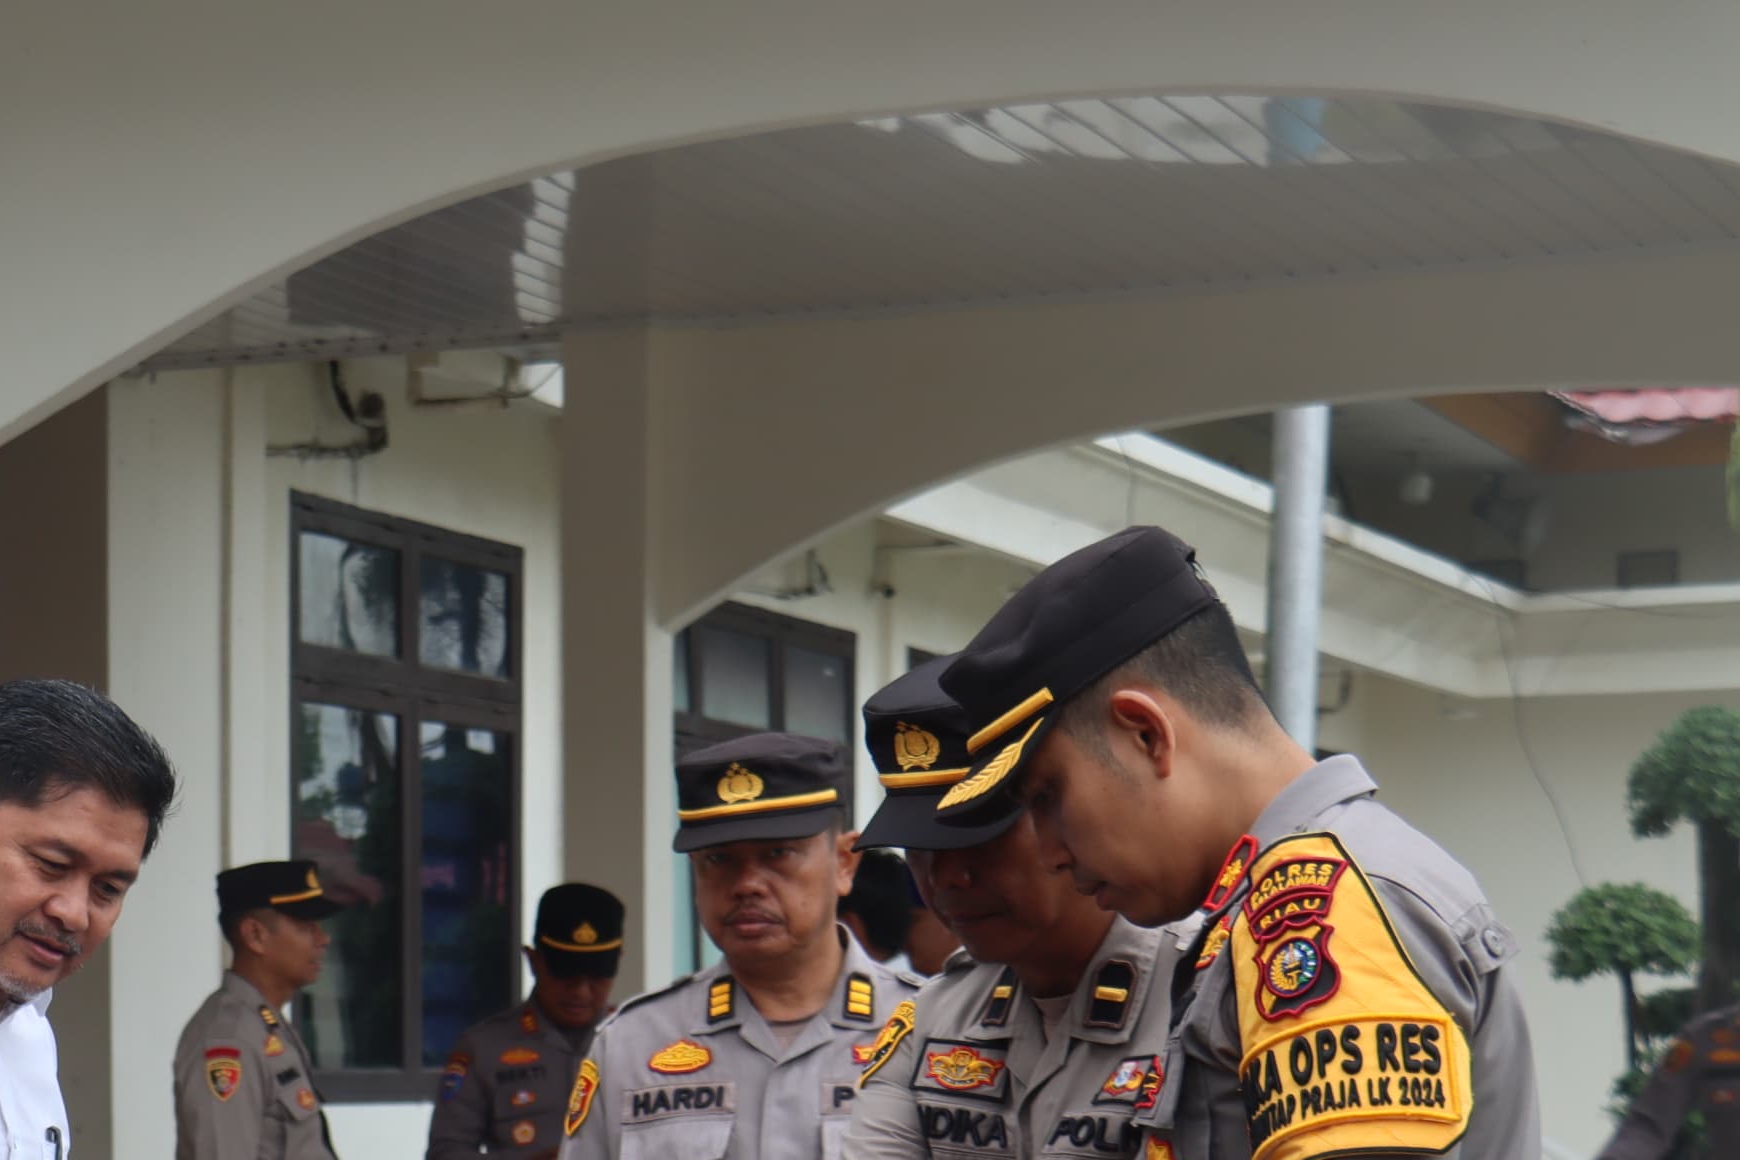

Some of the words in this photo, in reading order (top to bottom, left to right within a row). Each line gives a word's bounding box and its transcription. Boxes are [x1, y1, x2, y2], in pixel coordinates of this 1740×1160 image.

[1250, 863, 1333, 911] POLRES
[1260, 898, 1320, 929] RIAU
[1289, 1025, 1363, 1086] OPS
[1376, 1023, 1441, 1075] RES
[632, 1086, 725, 1117] HARDI
[1300, 1078, 1362, 1120] PRAJA
[1368, 1077, 1392, 1106] LK
[1399, 1077, 1445, 1108] 2024
